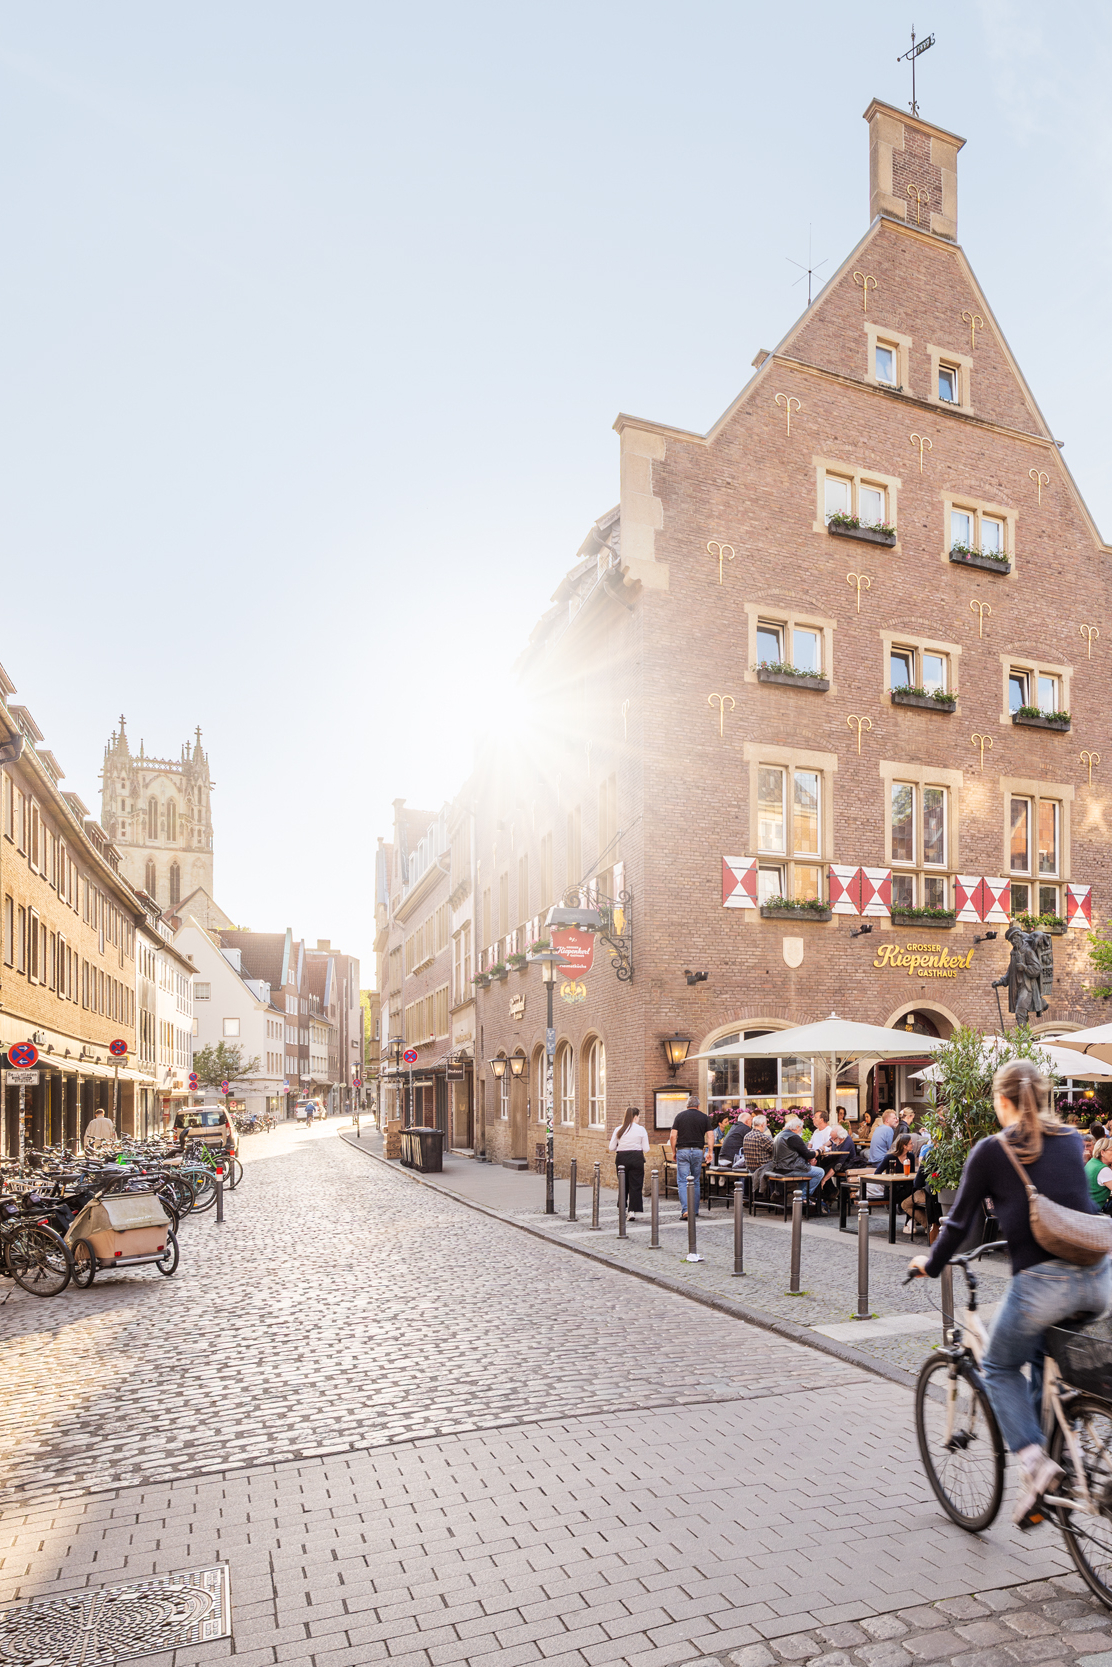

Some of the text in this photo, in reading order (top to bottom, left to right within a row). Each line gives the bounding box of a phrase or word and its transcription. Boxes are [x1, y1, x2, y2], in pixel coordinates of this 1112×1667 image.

[907, 943, 941, 952] GROSSER
[873, 944, 975, 976] Kiepenkerl
[917, 969, 957, 978] GASTHAUS
